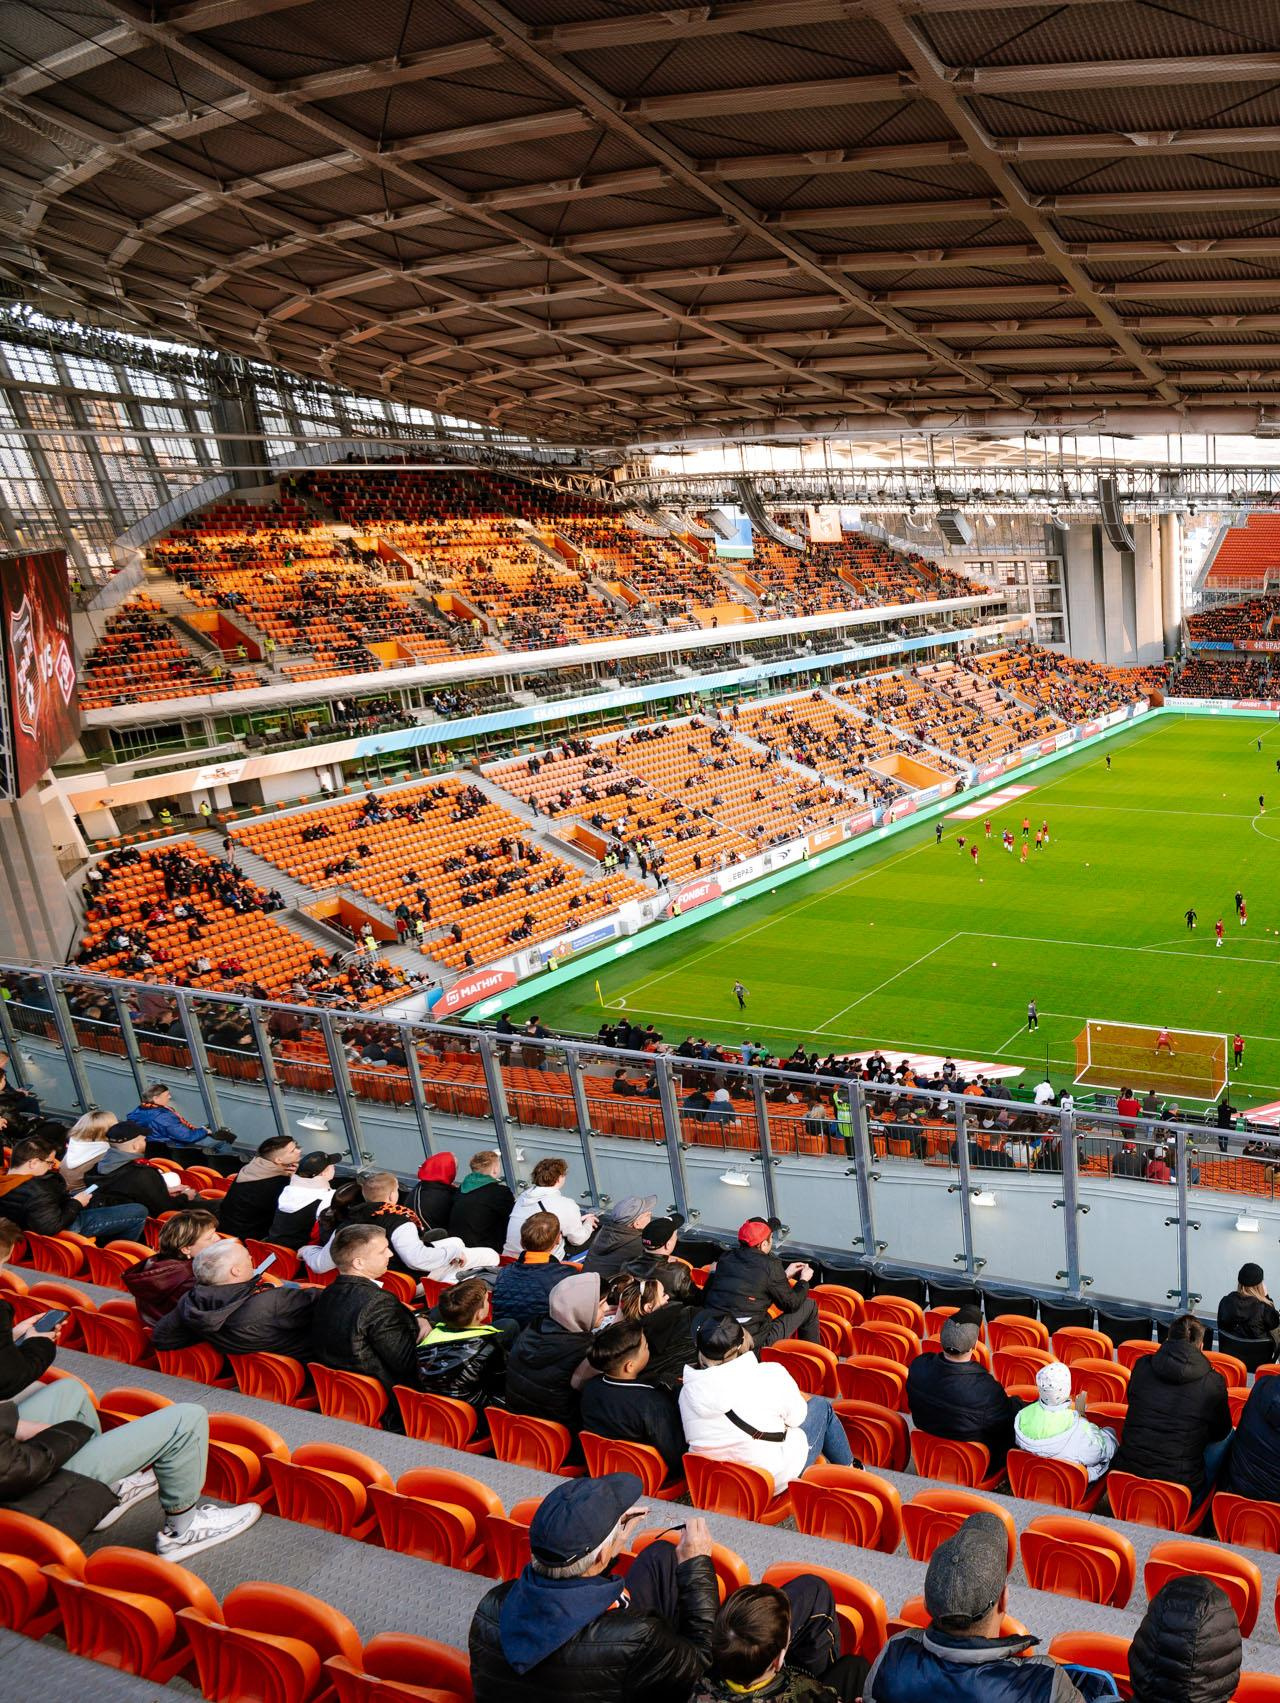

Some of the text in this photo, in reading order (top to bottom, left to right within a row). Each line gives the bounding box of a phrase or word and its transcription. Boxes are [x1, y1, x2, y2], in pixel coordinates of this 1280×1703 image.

[1253, 641, 1265, 649] ФК
[678, 884, 710, 905] FONBET
[460, 972, 504, 998] МАГНИТ
